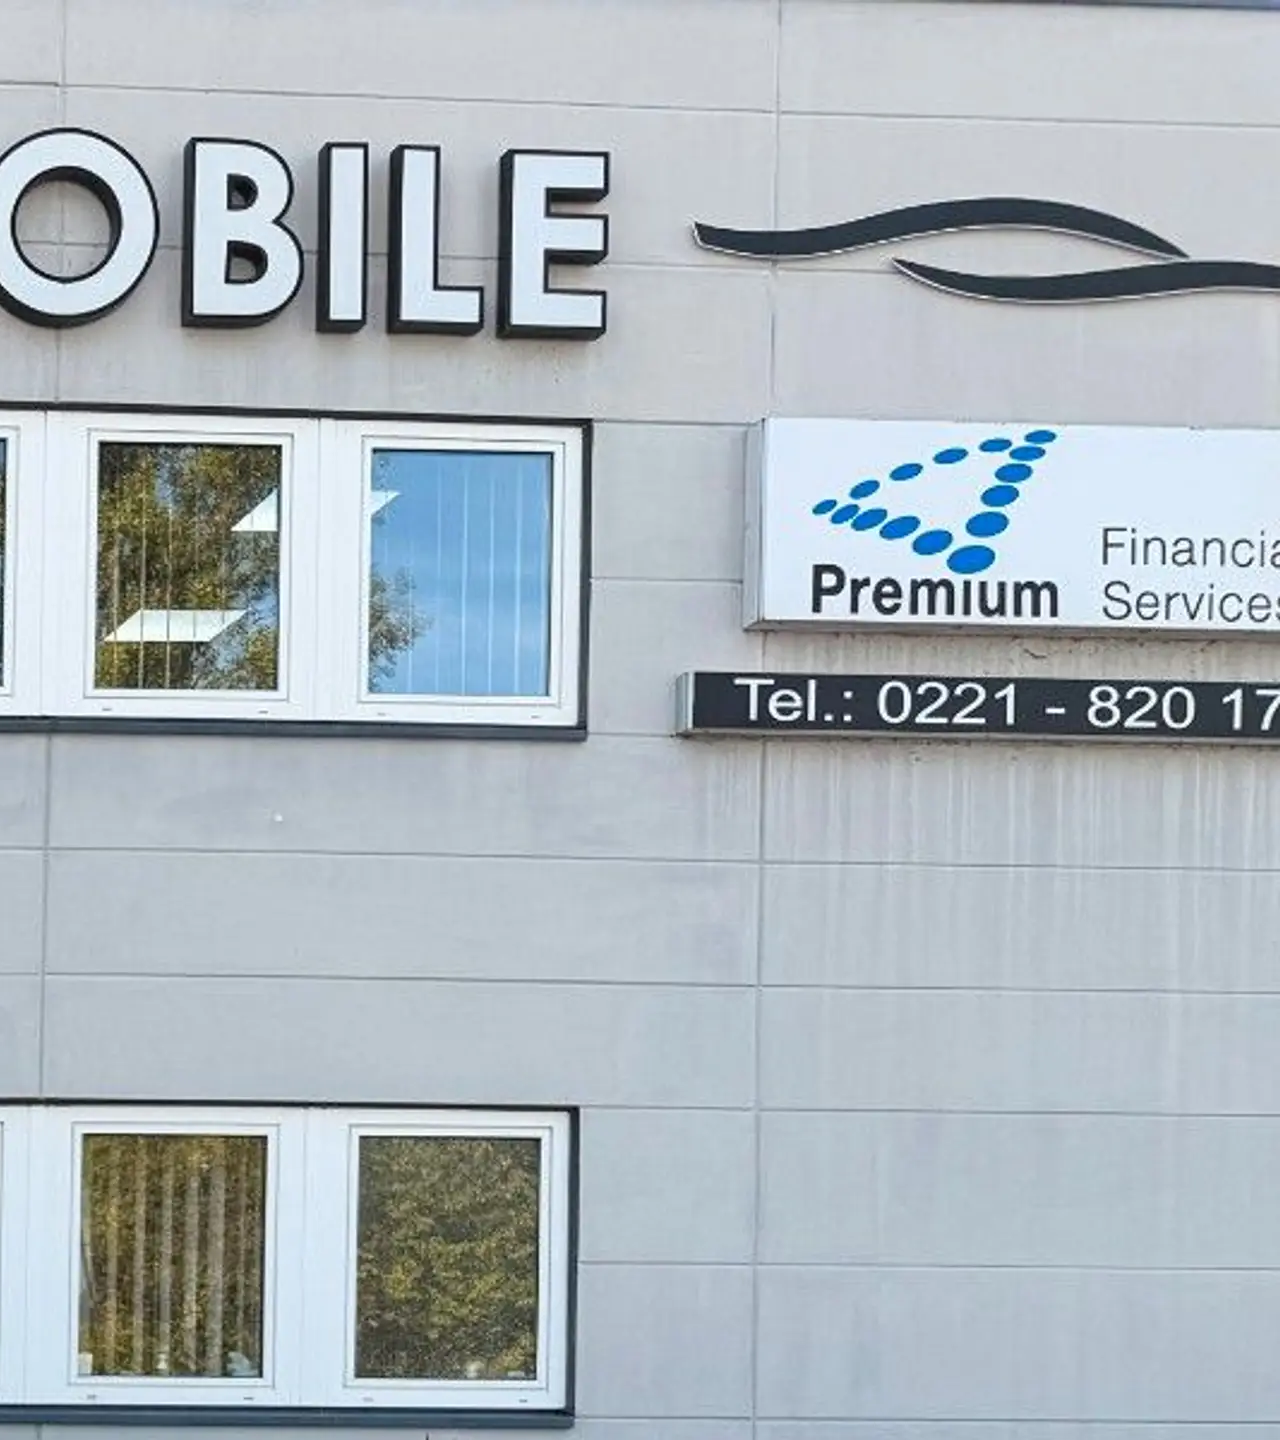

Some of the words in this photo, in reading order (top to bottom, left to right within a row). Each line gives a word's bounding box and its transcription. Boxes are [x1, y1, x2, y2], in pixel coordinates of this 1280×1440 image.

[811, 563, 1060, 618] Premium
[1102, 580, 1280, 623] Service
[735, 678, 853, 723] Tel.:
[877, 680, 1017, 726] 0221
[1087, 685, 1196, 729] 820
